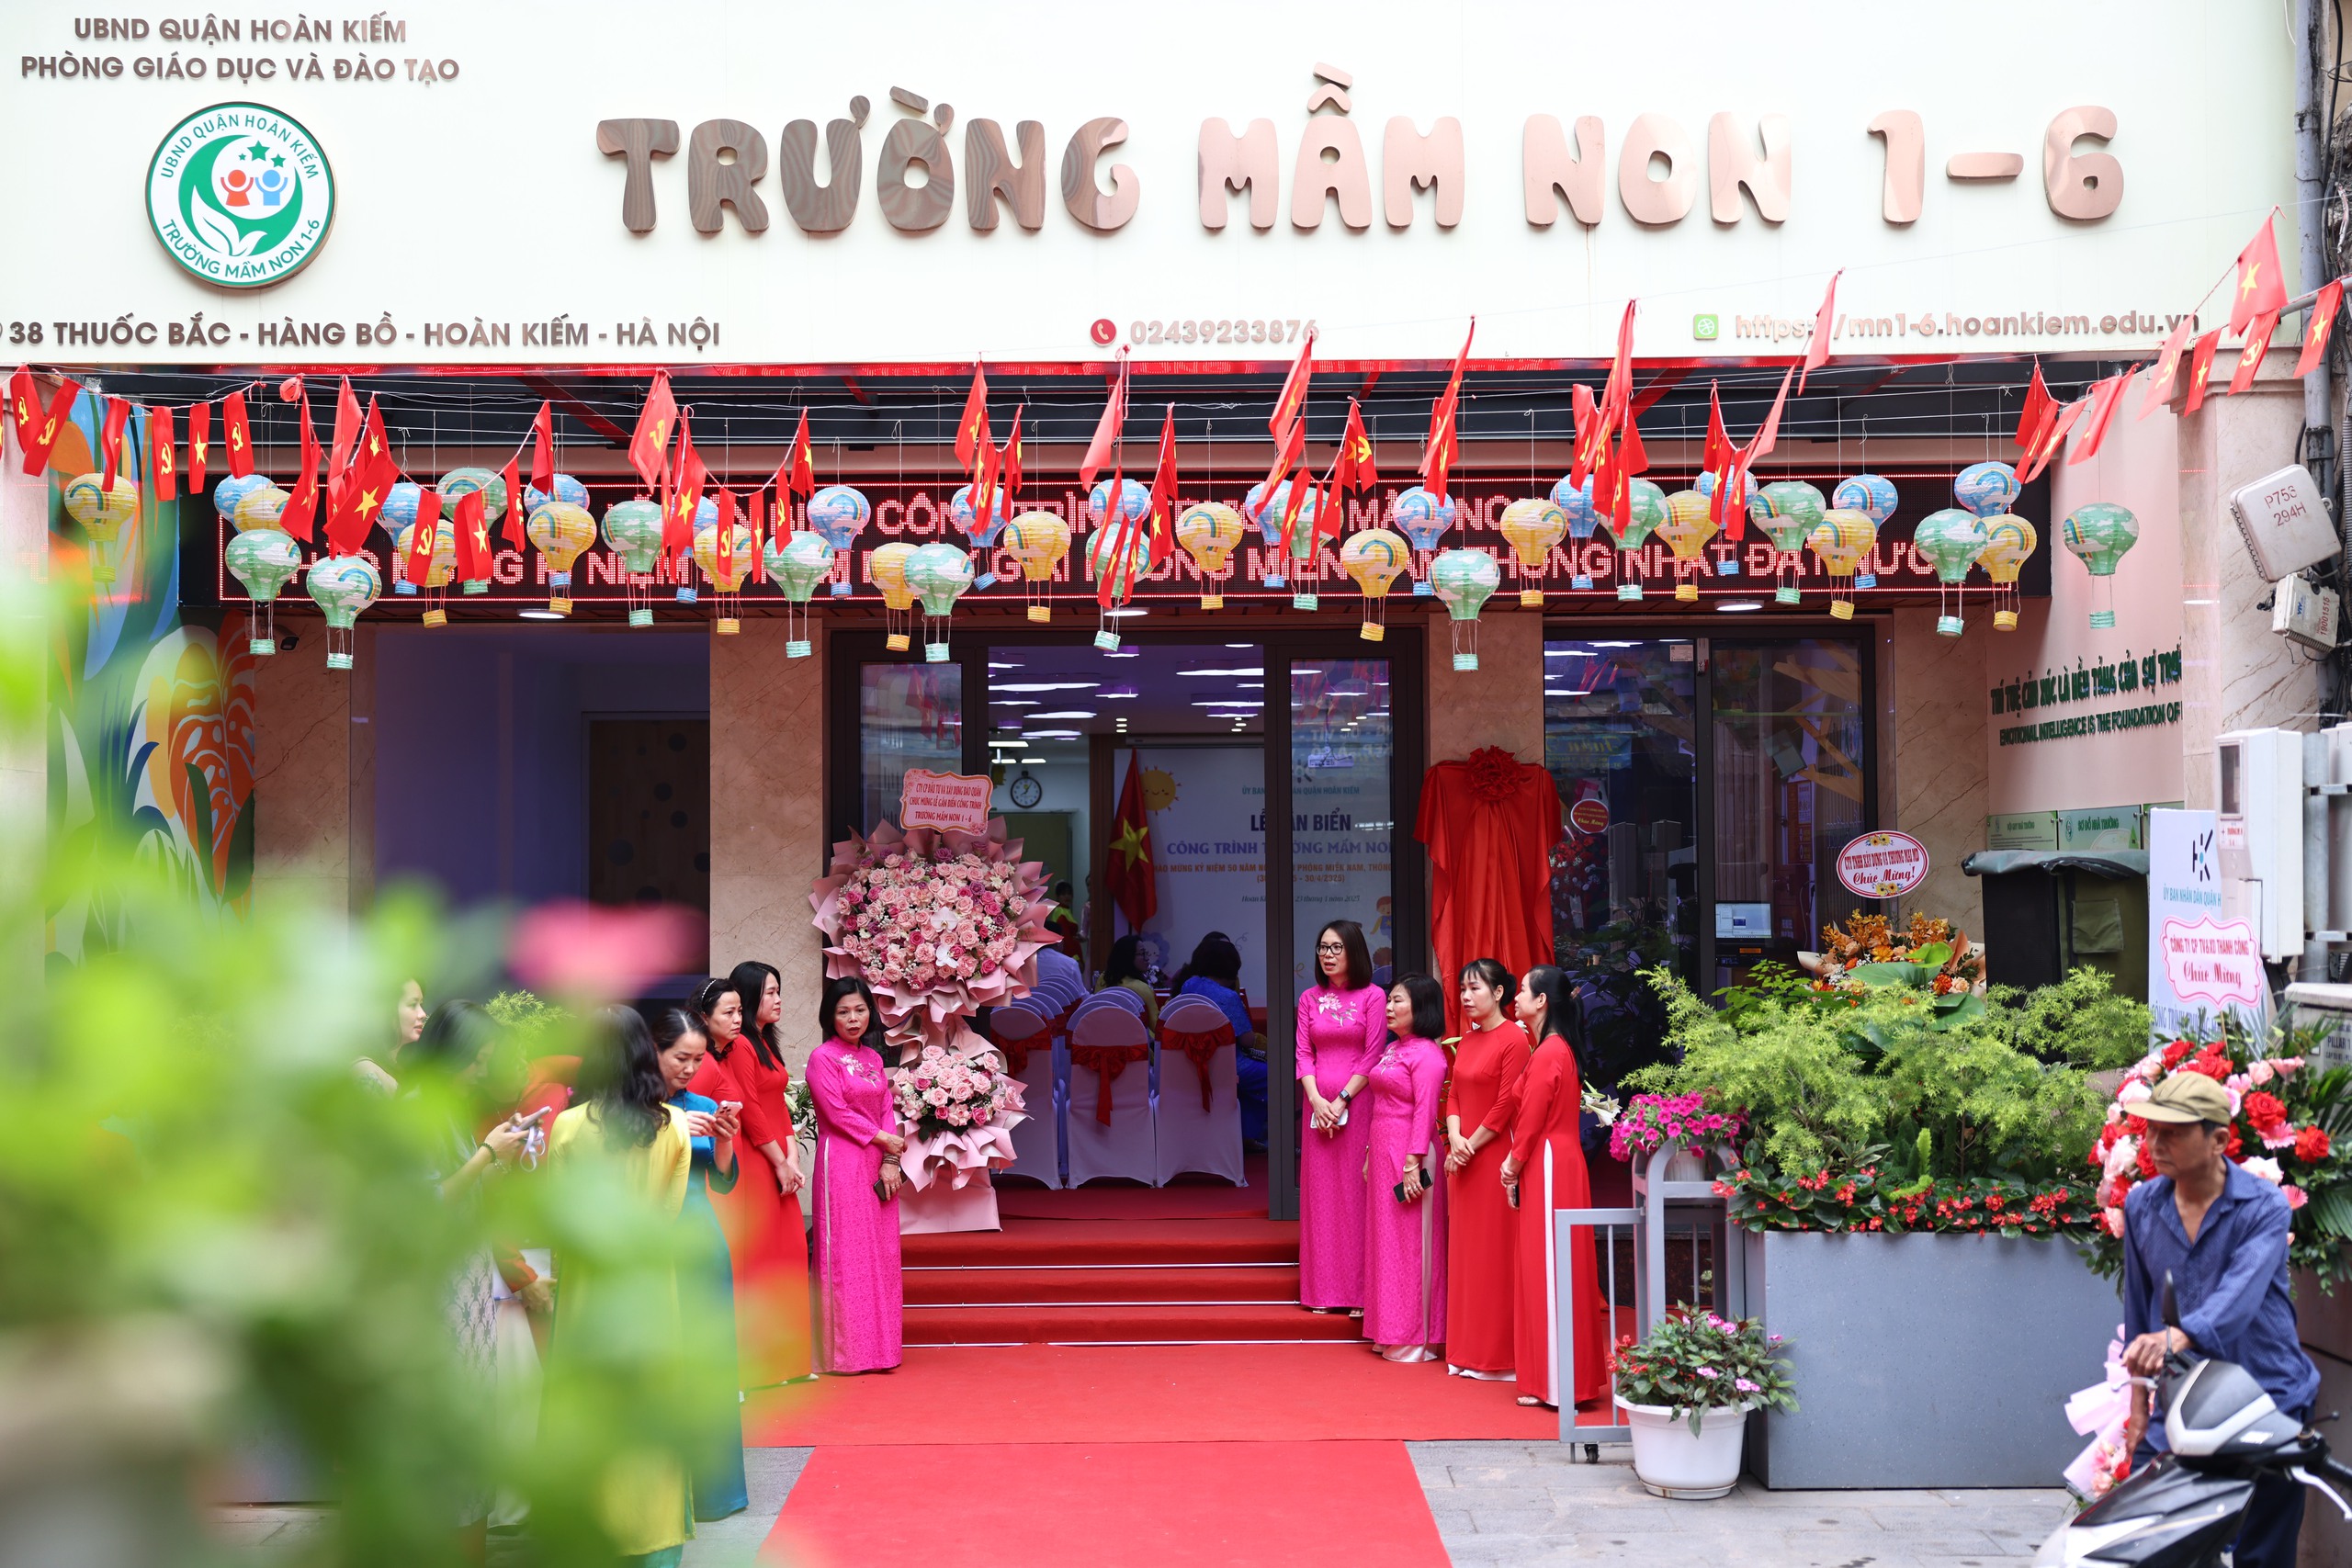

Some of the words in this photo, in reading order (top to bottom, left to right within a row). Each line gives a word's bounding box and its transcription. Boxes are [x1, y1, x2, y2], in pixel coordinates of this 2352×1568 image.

[74, 18, 150, 41] UBND
[158, 15, 241, 46] QUẬN
[250, 13, 329, 42] HOÀN
[343, 10, 408, 42] KIẾM
[21, 51, 124, 80] PHÒNG
[132, 49, 208, 80] GIÁO
[217, 57, 277, 85] DỤC
[286, 50, 324, 81] VÀ
[333, 50, 397, 81] ĐÀO
[404, 58, 460, 85] TẠO
[161, 136, 192, 178] UBND
[193, 114, 239, 139] QUẬN
[244, 114, 291, 142] HOÀN
[289, 140, 319, 179] KIẾM
[595, 85, 1141, 234] TRƯỜNG
[1197, 61, 1464, 231] MẦM
[1523, 111, 1792, 228] NON
[1867, 104, 2124, 225] 1-6
[162, 219, 220, 274] TRƯỜNG
[225, 261, 266, 278] MẦM
[268, 241, 305, 272] NON
[300, 220, 320, 241] 1-6
[9, 321, 43, 344] 38
[54, 312, 159, 347] THUỐC
[168, 312, 232, 347] BẮC
[257, 317, 345, 347] HÀNG
[356, 311, 398, 347] BỒ
[424, 317, 511, 347] HOÀN
[522, 313, 589, 347] KIẾM
[616, 317, 658, 346] HÀ
[667, 317, 720, 352] NỘI
[1130, 320, 1319, 344] 02439233876
[2274, 502, 2306, 526] 294H
[2320, 596, 2331, 637] 19001515
[2000, 725, 2039, 746] EMOTIONAL
[2039, 716, 2086, 741] INTELLIGENCE
[2087, 714, 2096, 734] IS
[2096, 712, 2111, 733] THE
[2112, 704, 2165, 730] FOUNDATION
[2166, 702, 2180, 722] OF
[949, 813, 960, 822] NON
[1313, 807, 1351, 831] BIỂN
[1167, 840, 1209, 855] CÔNG
[1216, 840, 1257, 854] TRÌNH
[1227, 863, 1238, 873] 50
[1853, 872, 1878, 886] Chúc
[1881, 866, 1916, 882] Mừng!
[2184, 961, 2210, 983] Chúc
[2212, 963, 2243, 989] Mừng
